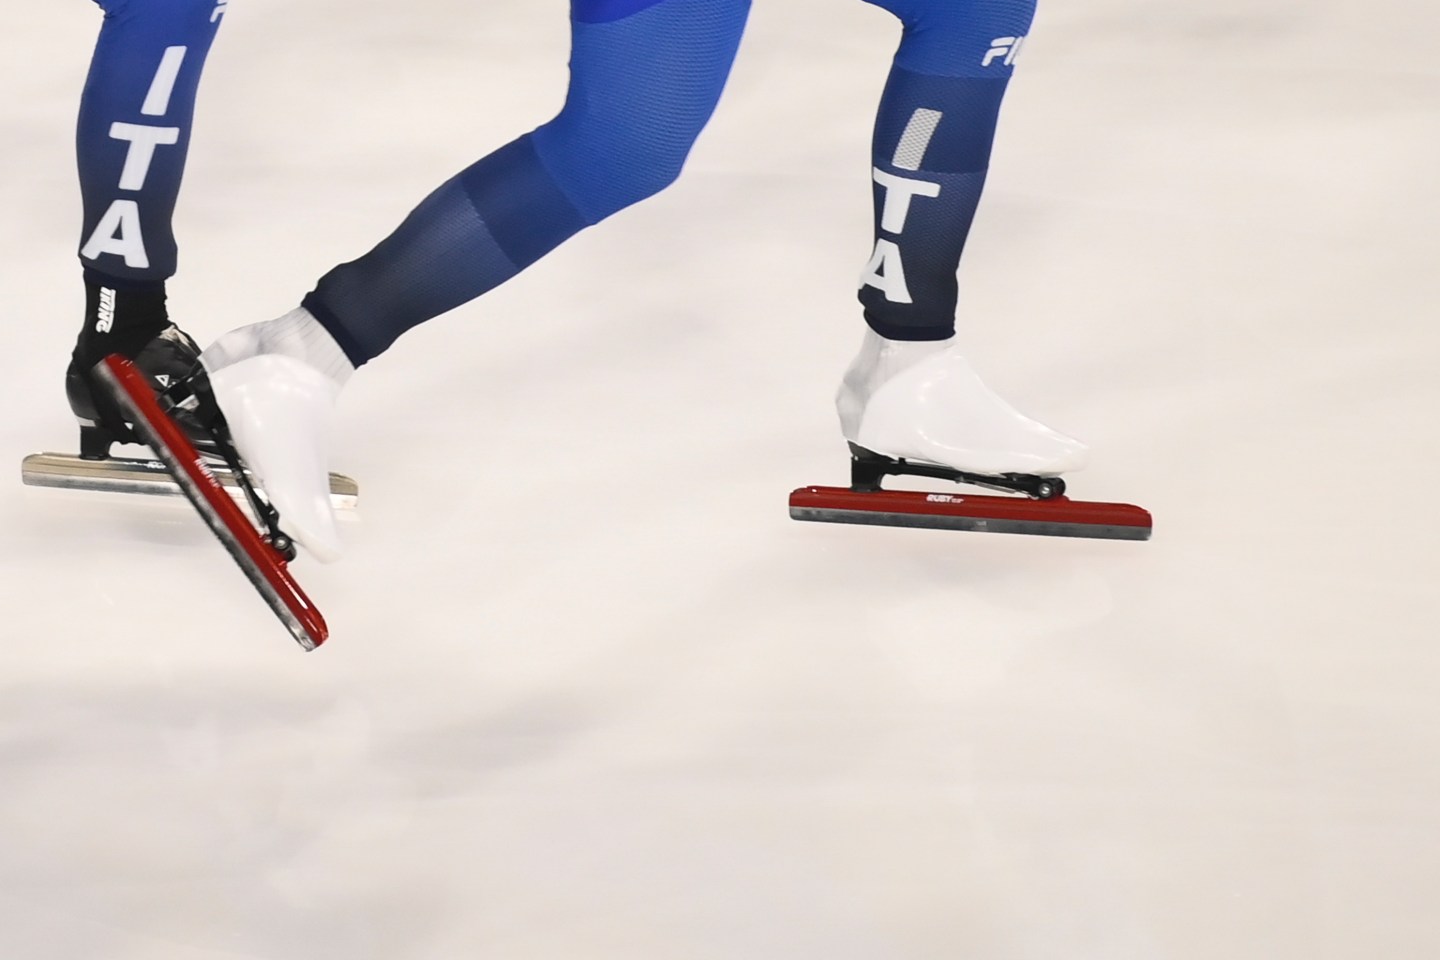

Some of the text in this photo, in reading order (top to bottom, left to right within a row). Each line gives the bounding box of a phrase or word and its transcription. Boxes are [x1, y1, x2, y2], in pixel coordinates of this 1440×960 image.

[981, 36, 1024, 66] FI
[81, 45, 187, 269] ITA
[860, 107, 943, 304] ITA
